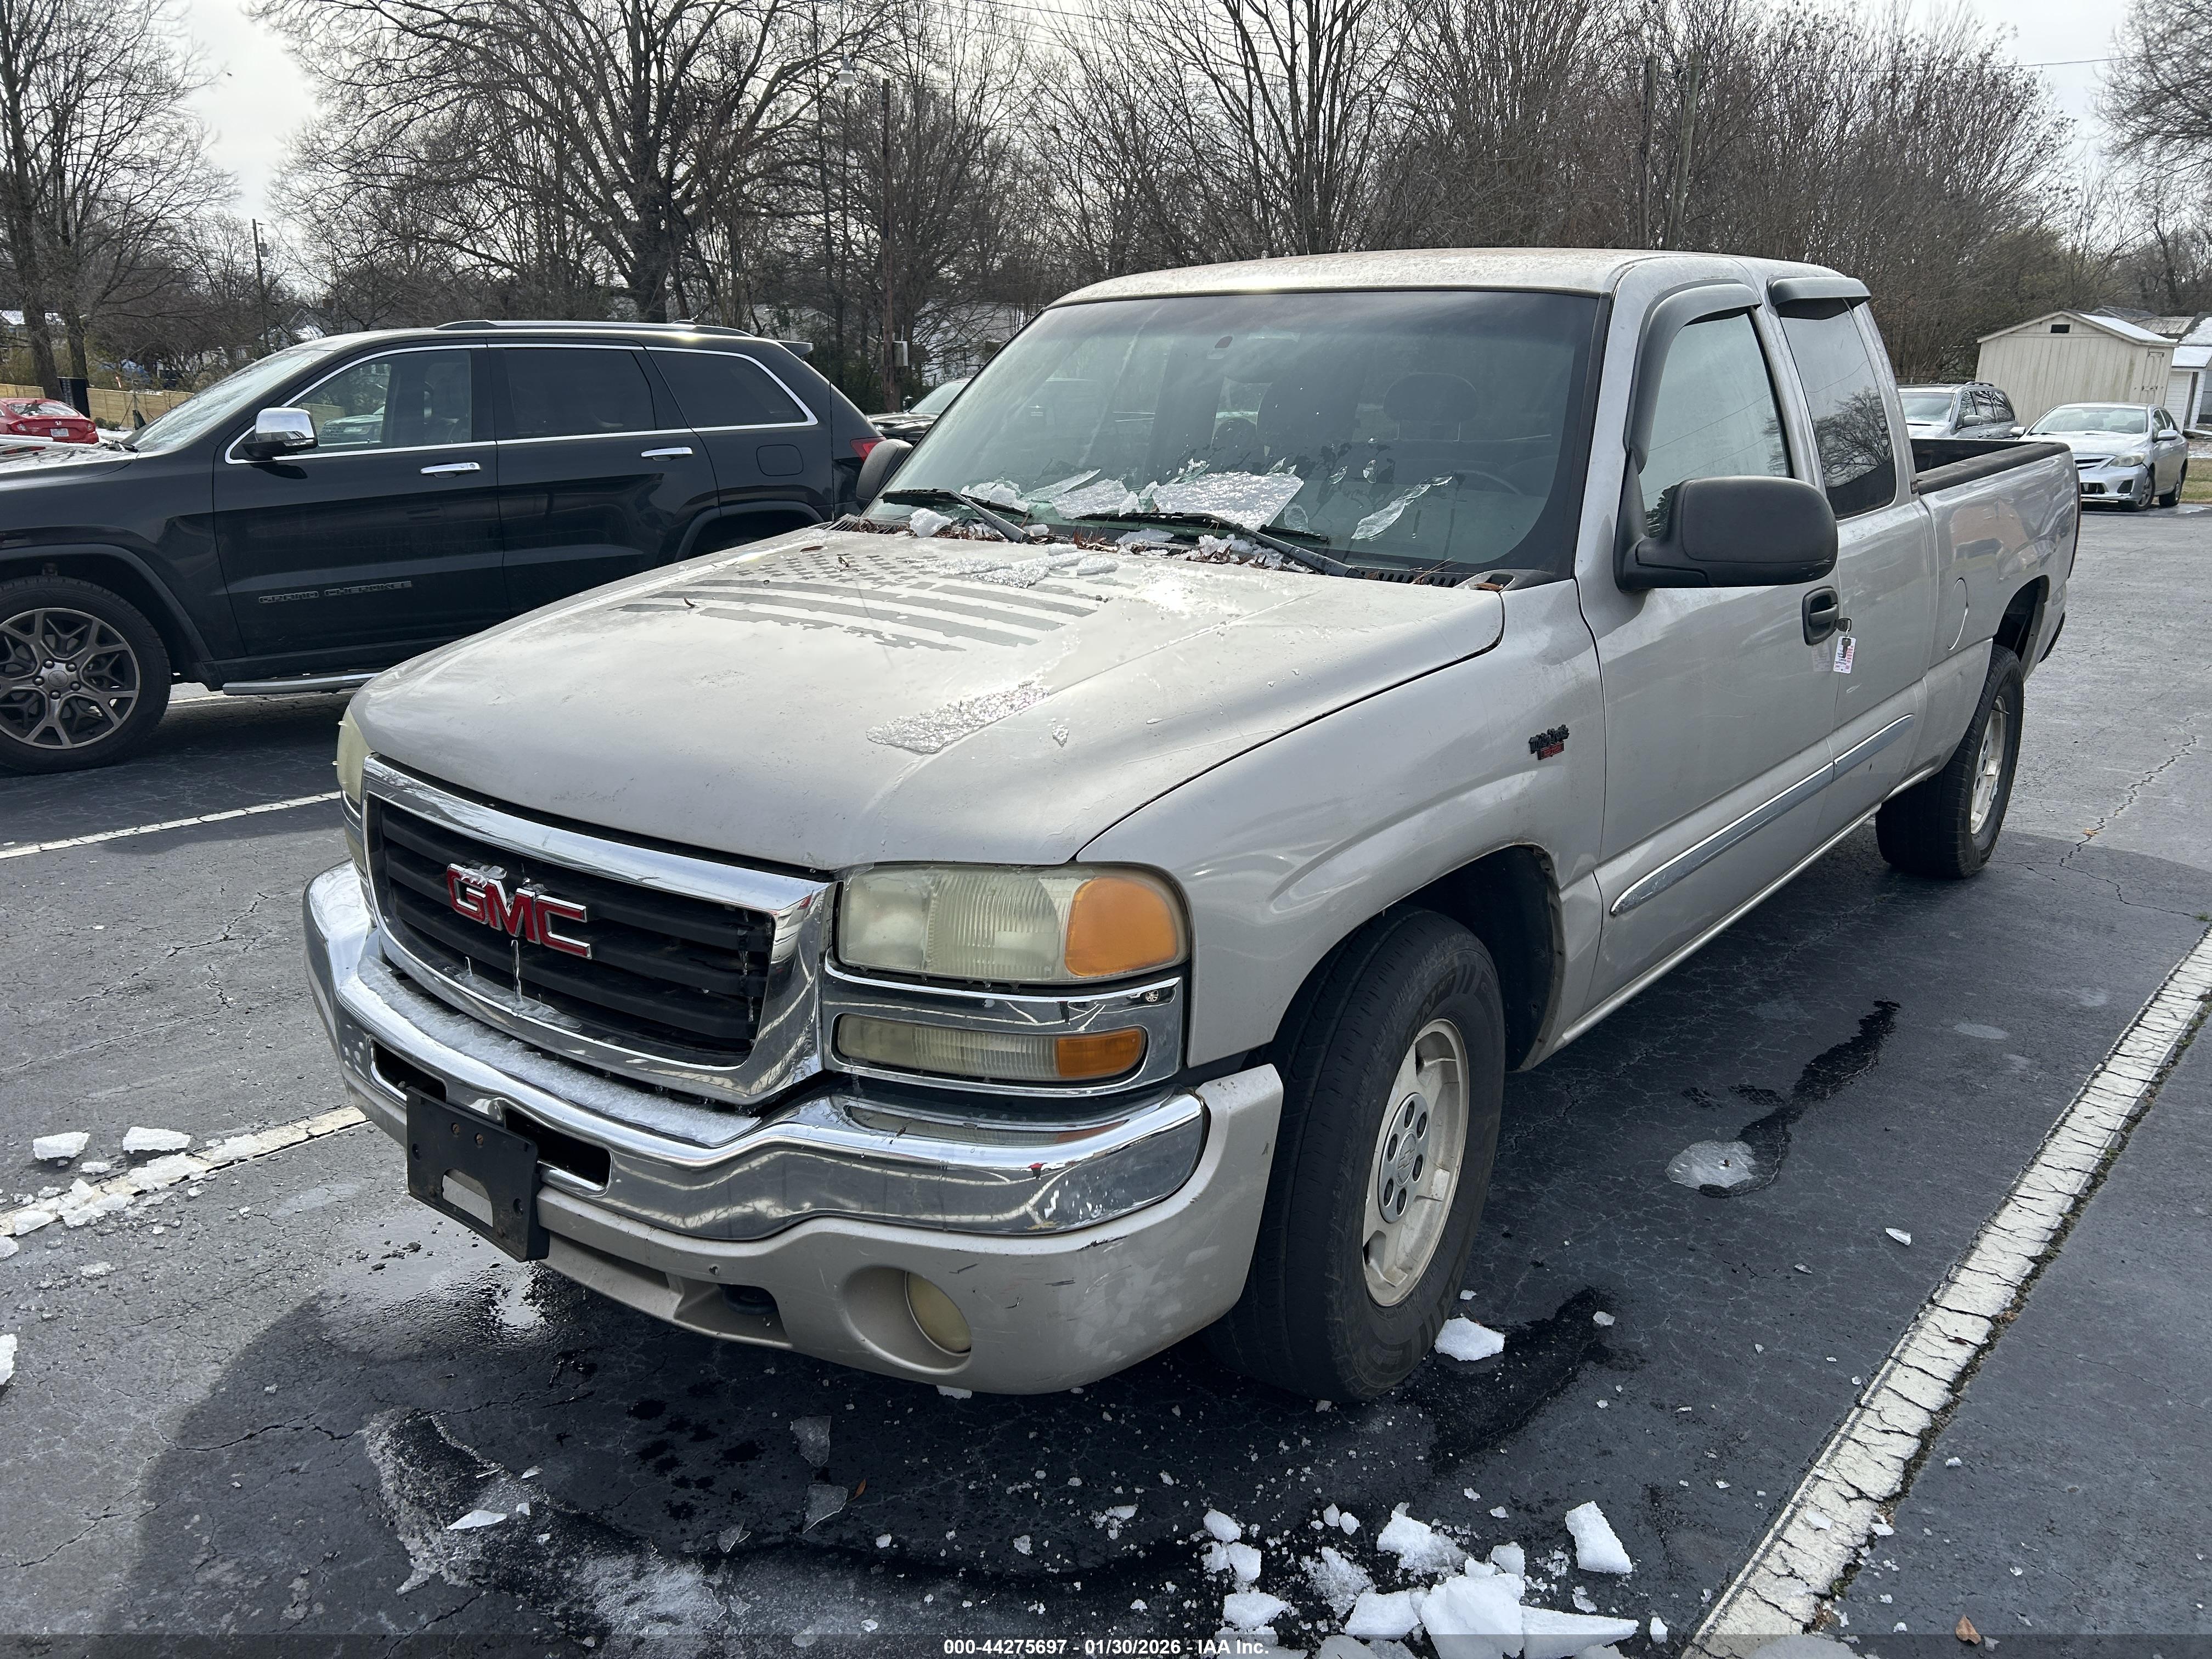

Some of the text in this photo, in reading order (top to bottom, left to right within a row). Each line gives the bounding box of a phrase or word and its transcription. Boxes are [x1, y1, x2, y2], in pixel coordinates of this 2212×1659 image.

[258, 580, 413, 604] GRAND CHEROKEE
[447, 863, 592, 960] GMC
